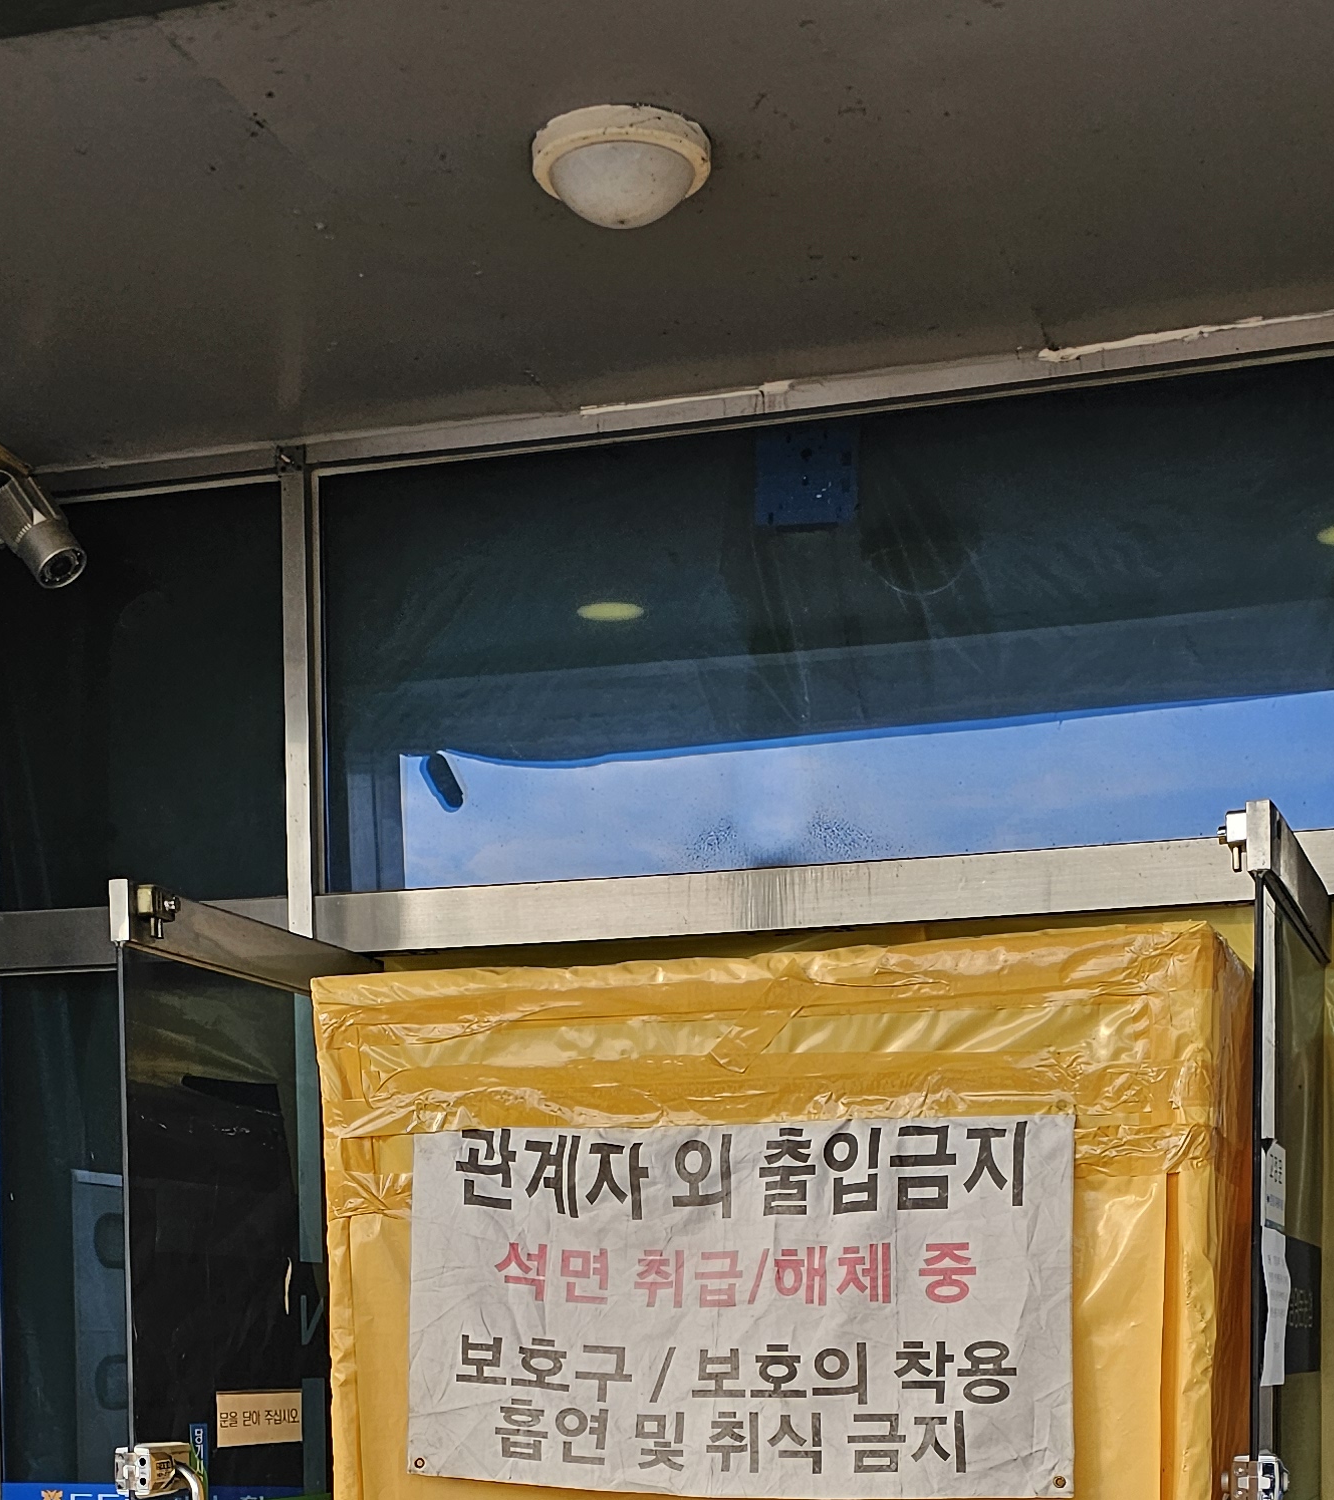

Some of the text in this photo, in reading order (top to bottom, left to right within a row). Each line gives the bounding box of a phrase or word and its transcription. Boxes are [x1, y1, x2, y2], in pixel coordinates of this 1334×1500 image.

[455, 1120, 1029, 1220] 관계자 외 출입금지
[494, 1241, 977, 1308] 석면 취급/해체 중
[455, 1334, 1018, 1404] 보호구 / 보호의 착용
[220, 1408, 300, 1428] 문을 닫아 주십시오
[495, 1398, 967, 1474] 흡연 및 취식 금지
